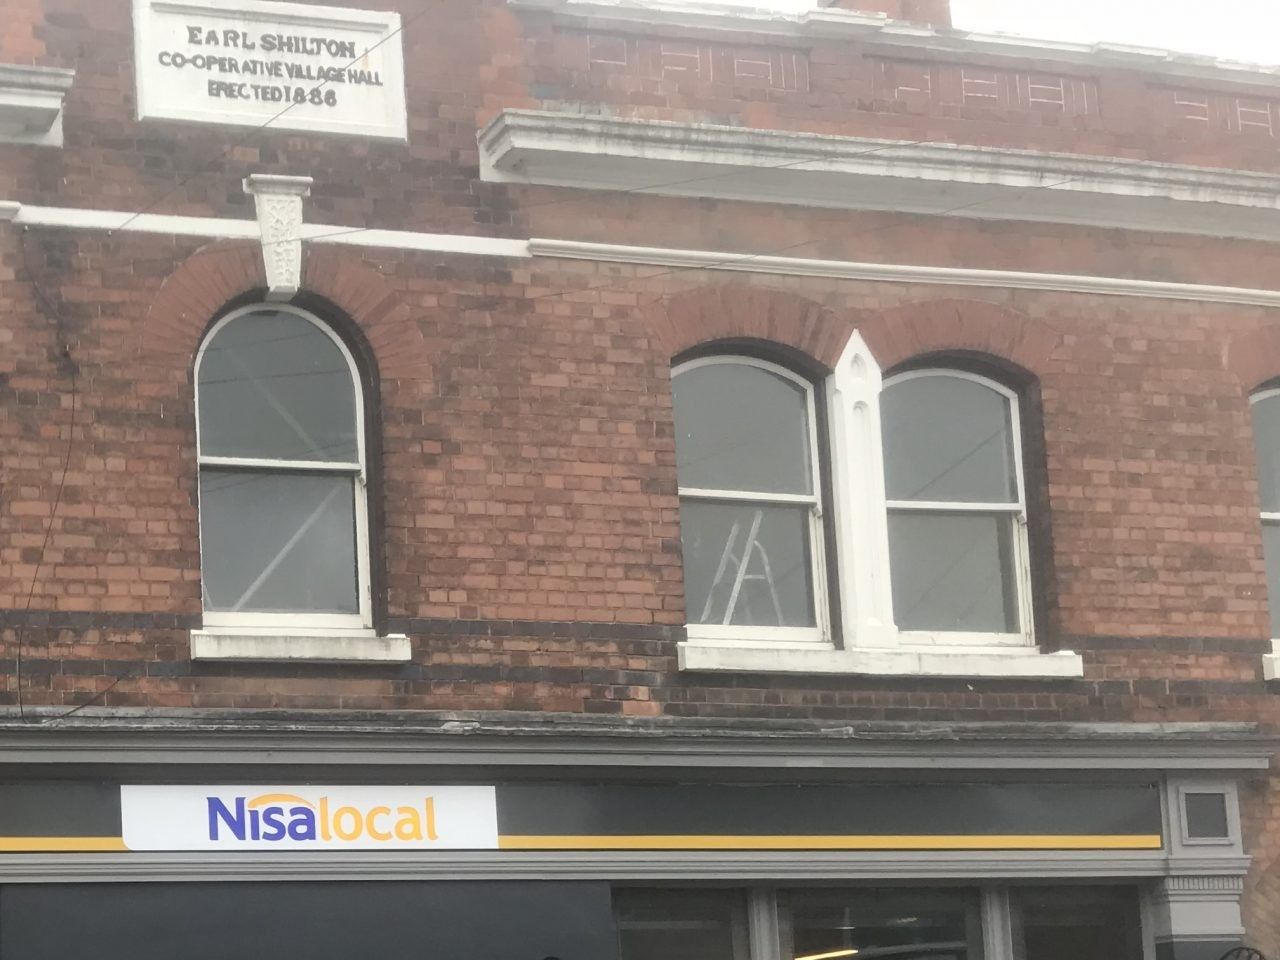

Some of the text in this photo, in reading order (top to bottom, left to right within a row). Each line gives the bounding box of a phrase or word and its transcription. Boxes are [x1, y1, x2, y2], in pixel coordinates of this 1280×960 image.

[187, 25, 356, 59] EARL SHILTON
[158, 51, 384, 87] CO-OPERATIVE VILLAGE HALL
[207, 79, 282, 102] ERECTED
[206, 794, 439, 841] Nisalocal
